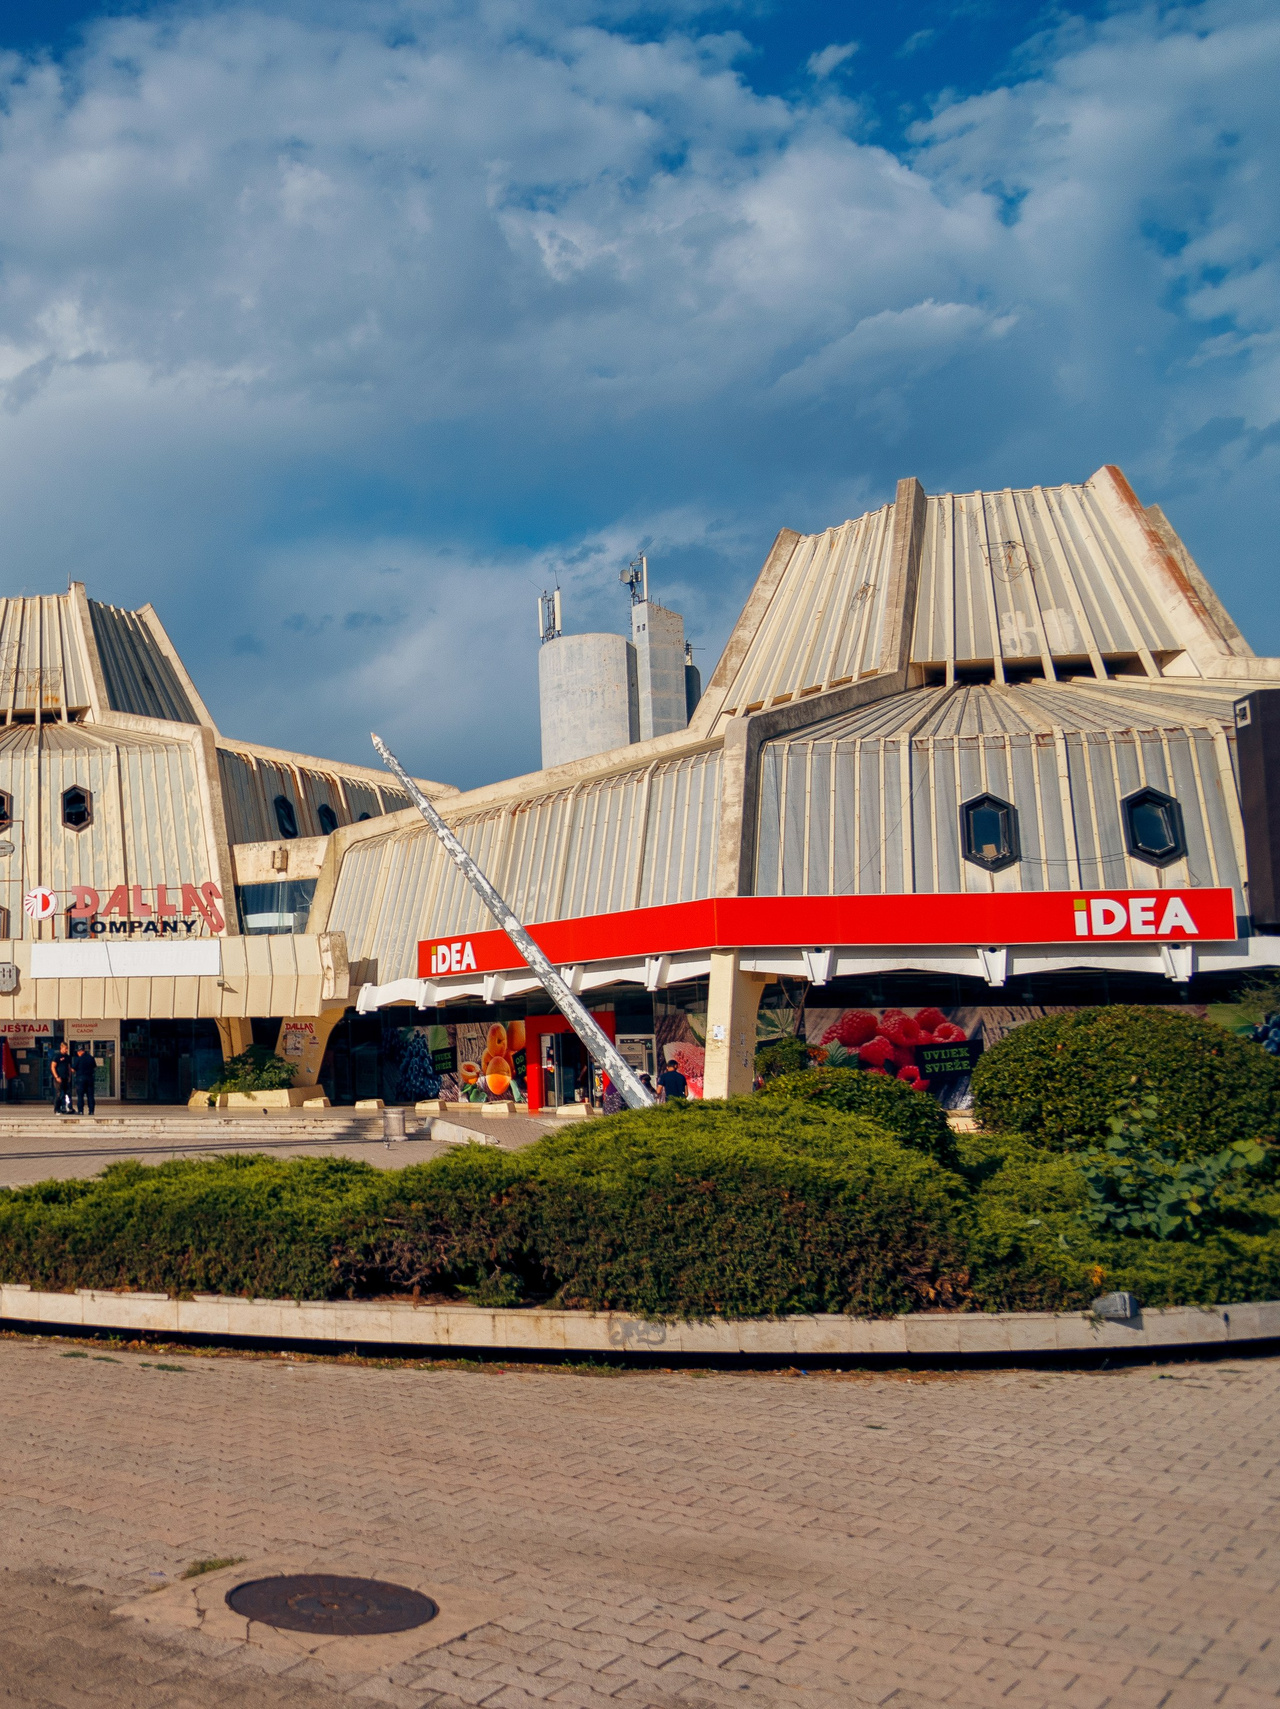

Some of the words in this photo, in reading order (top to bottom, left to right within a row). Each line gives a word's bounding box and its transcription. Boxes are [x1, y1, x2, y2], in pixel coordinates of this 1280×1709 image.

[71, 881, 225, 933] DALLAS
[72, 919, 198, 935] COMPANY
[284, 1022, 315, 1034] DALLAS
[922, 1047, 970, 1061] UVIJEK
